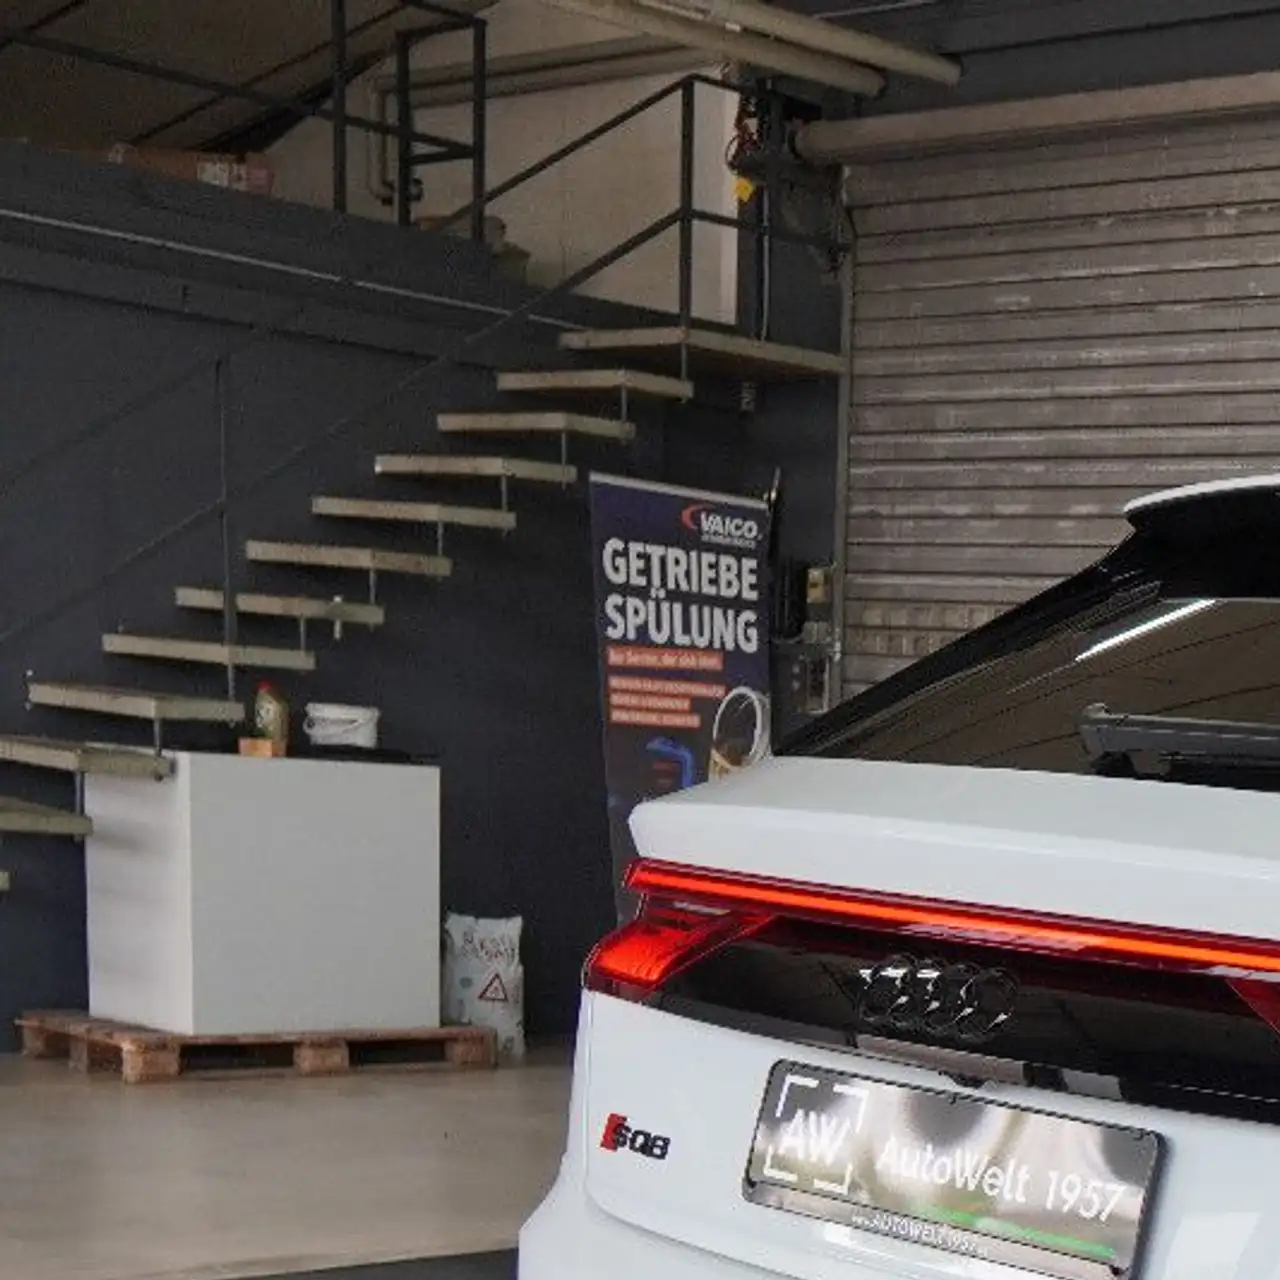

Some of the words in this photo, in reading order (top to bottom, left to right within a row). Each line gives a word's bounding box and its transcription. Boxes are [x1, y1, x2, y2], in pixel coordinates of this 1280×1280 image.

[602, 537, 759, 601] GETRIEBE
[604, 587, 758, 654] SPÜLUNG
[777, 1107, 851, 1170] AW
[875, 1136, 1031, 1204] AutoWelt
[1046, 1169, 1127, 1224] 1957
